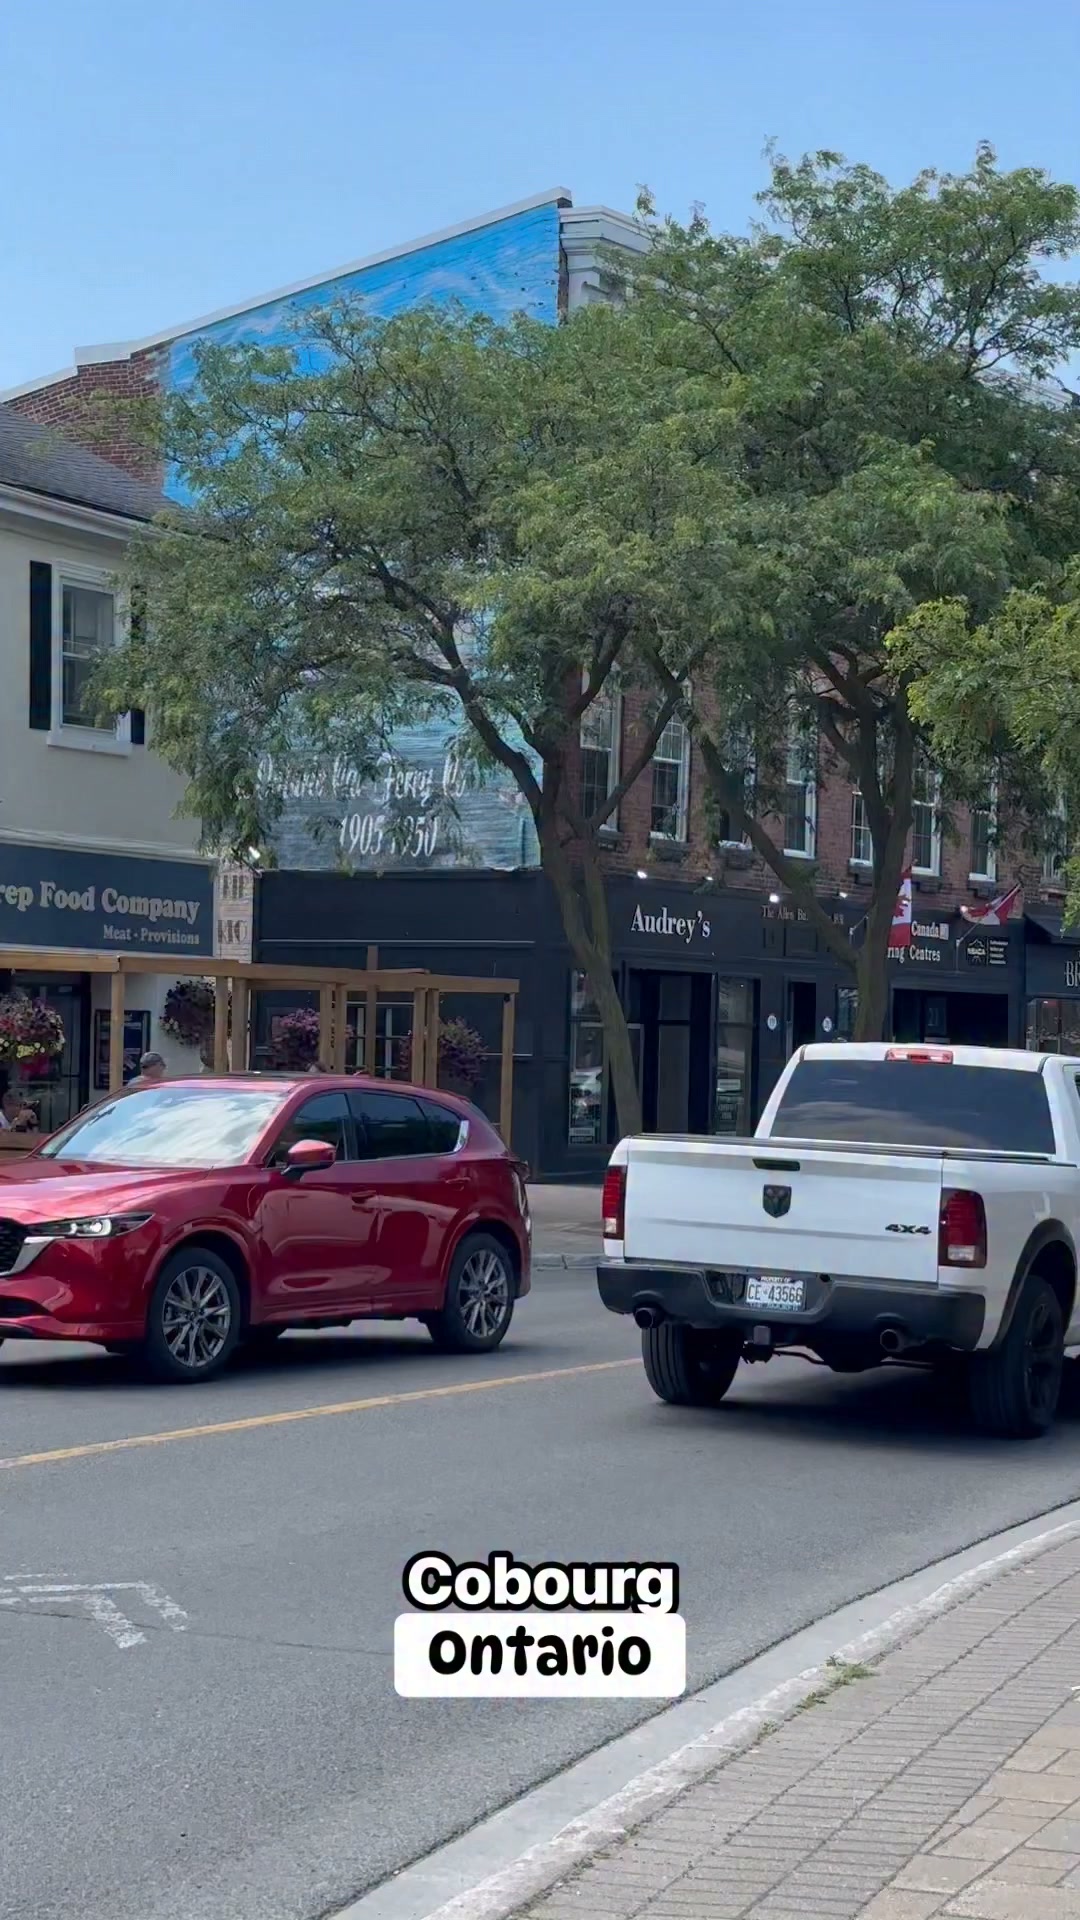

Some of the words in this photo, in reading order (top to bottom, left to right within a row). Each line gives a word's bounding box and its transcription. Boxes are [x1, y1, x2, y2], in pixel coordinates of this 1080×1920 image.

[40, 881, 96, 911] Food
[101, 887, 200, 924] Company
[631, 904, 711, 944] Audrey's
[911, 920, 940, 938] Canada
[103, 924, 131, 941] Meat
[141, 927, 200, 945] Provisions
[910, 945, 941, 962] Centres
[748, 1284, 761, 1300] CE
[768, 1285, 803, 1303] 43566
